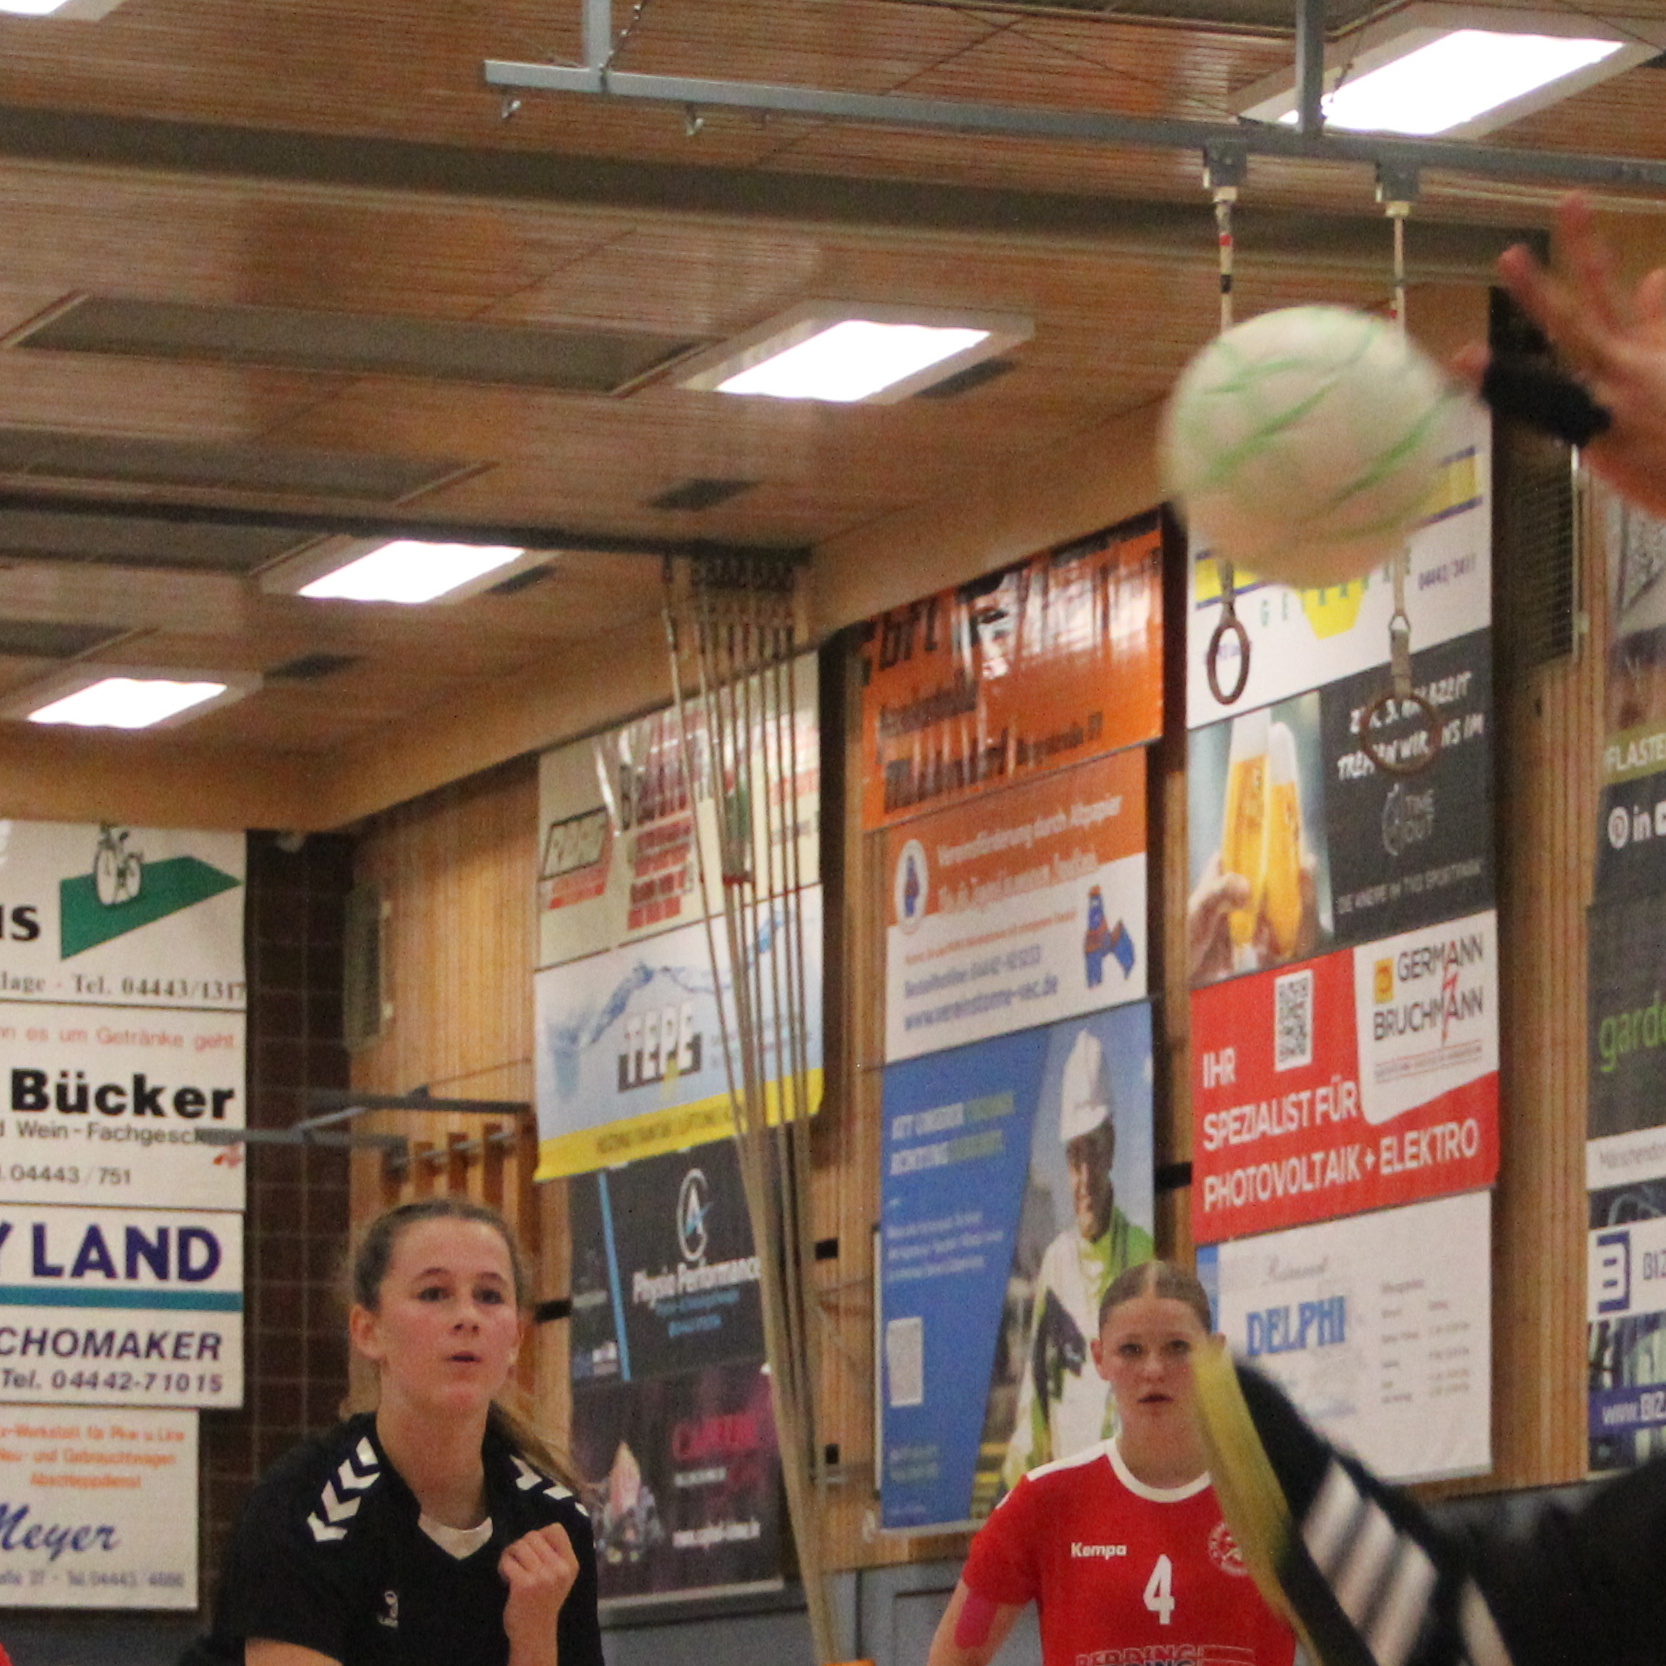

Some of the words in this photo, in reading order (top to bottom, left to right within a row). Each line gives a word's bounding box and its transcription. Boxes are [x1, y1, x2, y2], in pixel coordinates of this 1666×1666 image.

[1397, 933, 1484, 983] GERMANN
[59, 1028, 88, 1043] um
[96, 1026, 184, 1048] Getränke
[1374, 986, 1484, 1041] BRUCHMANN
[11, 1068, 235, 1120] Bücker
[1202, 1047, 1236, 1089] IHR
[1202, 1090, 1311, 1151] SPEZIALIST
[1314, 1074, 1359, 1126] FÜR
[1203, 1144, 1362, 1213] PHOTOVOLTAIK
[1380, 1117, 1481, 1176] ELEKTRO
[32, 1221, 222, 1282] LAND
[1246, 1295, 1347, 1357] DELPHI
[1070, 1541, 1128, 1560] Kempa
[1143, 1553, 1176, 1626] 4
